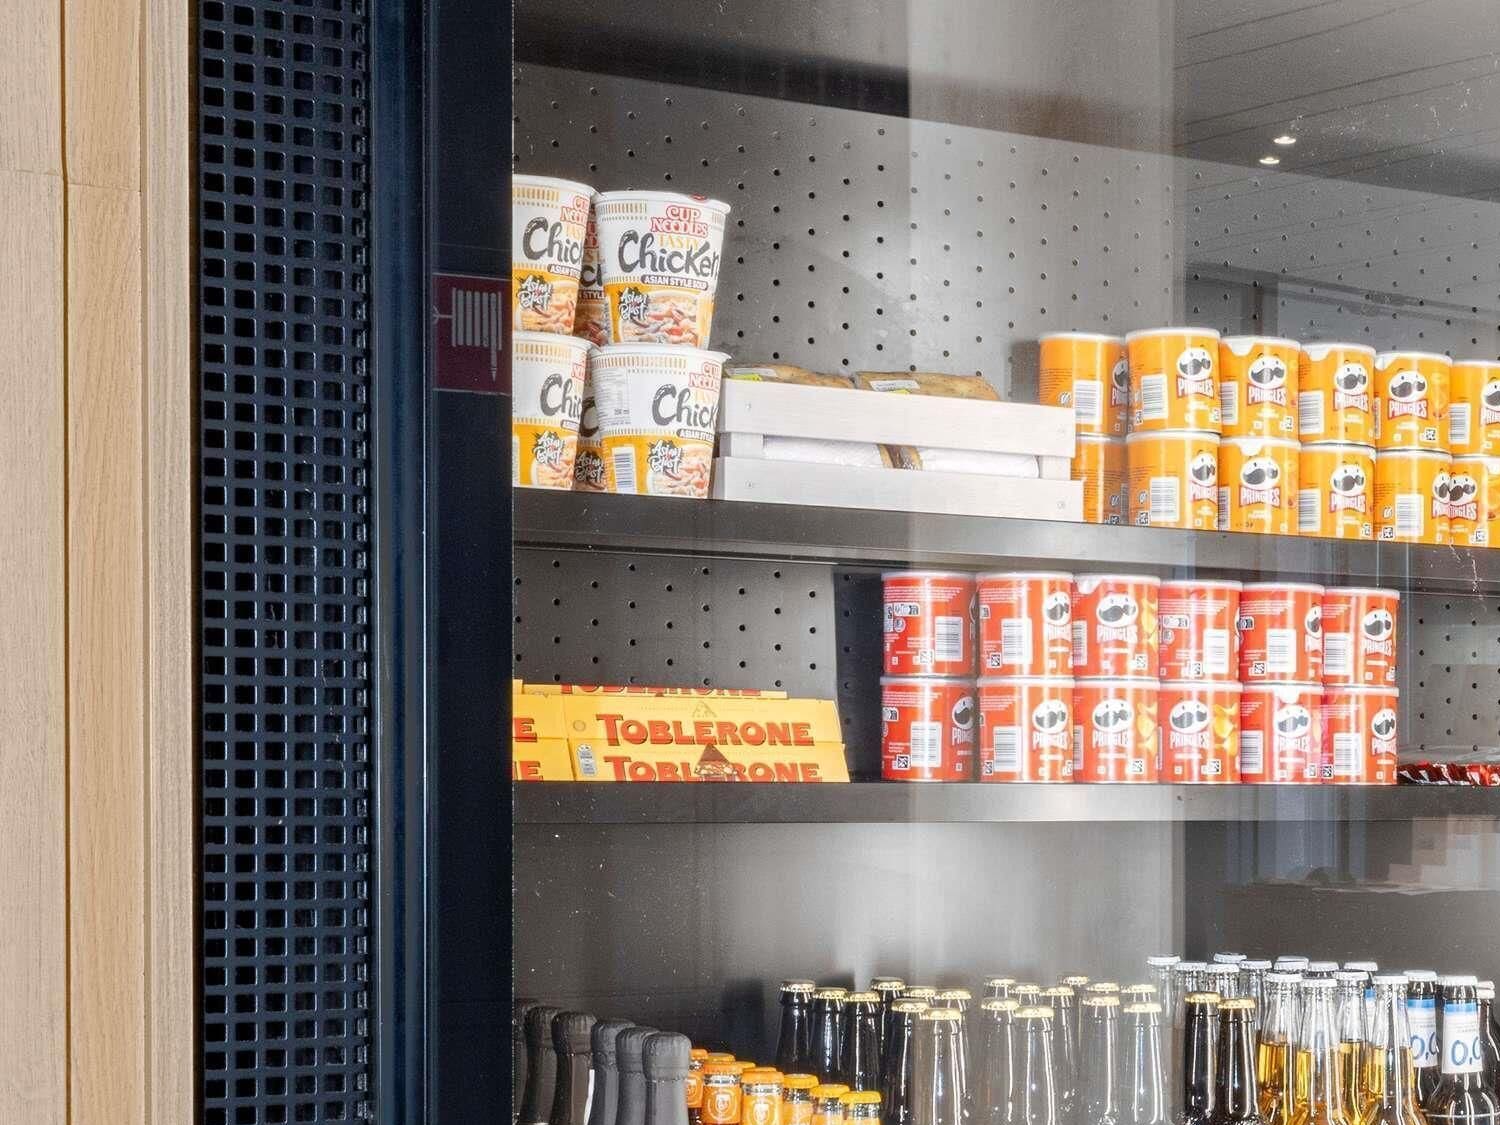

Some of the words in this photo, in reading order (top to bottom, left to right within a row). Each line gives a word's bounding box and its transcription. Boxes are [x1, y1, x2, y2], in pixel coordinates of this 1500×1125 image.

[666, 205, 700, 221] CUP
[522, 216, 582, 264] Chic
[652, 383, 720, 428] Chick
[596, 713, 815, 747] TOBLERONE
[604, 756, 823, 783] TOBLONE
